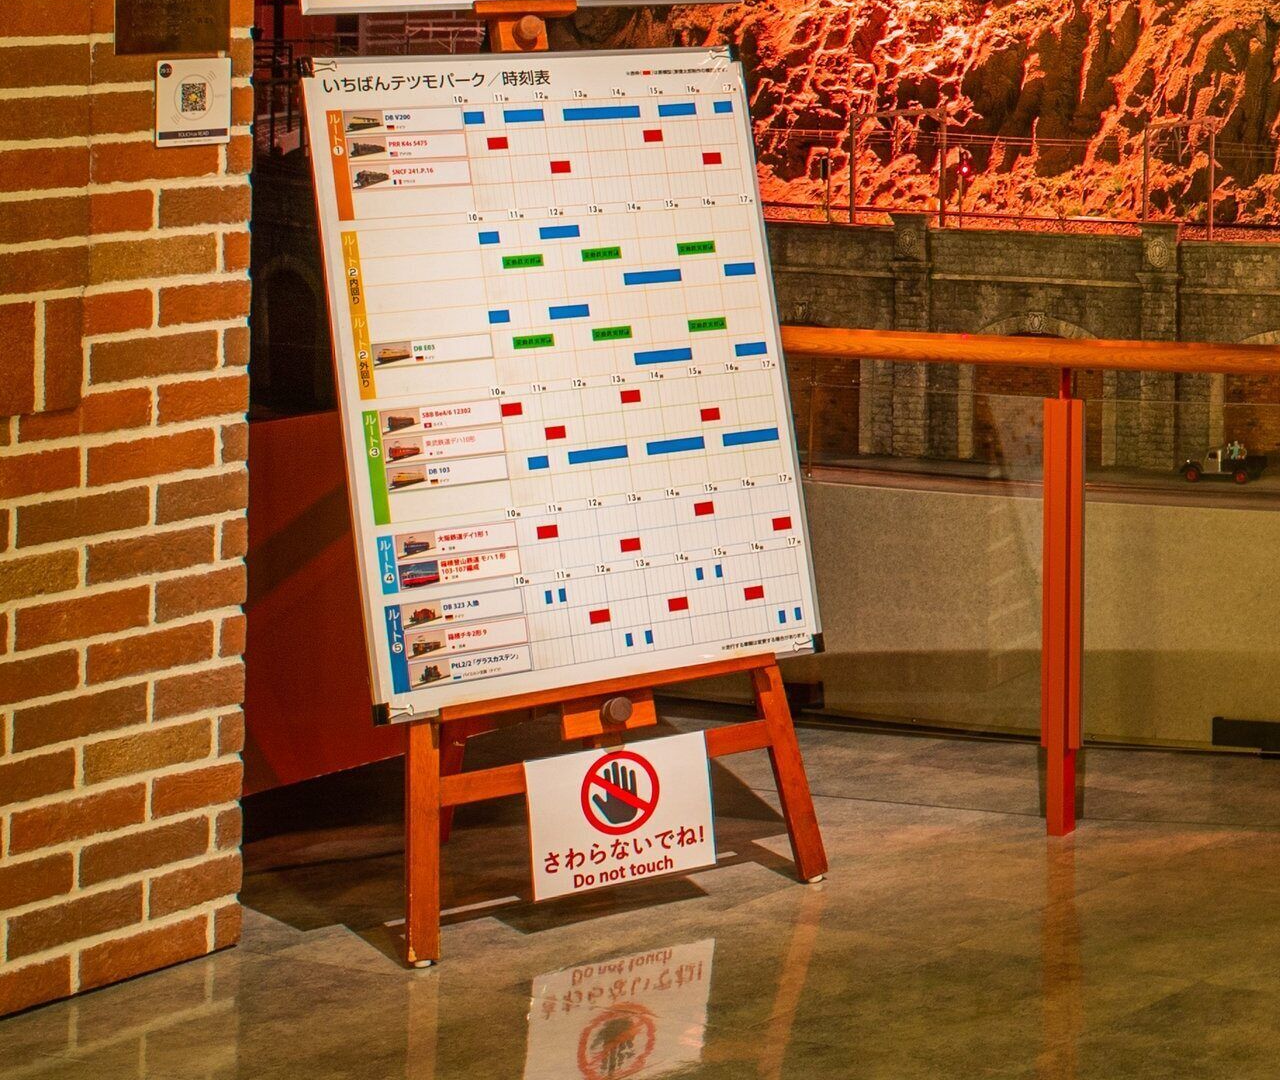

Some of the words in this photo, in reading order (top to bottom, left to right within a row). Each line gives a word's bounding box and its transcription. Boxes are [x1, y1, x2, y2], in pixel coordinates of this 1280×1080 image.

[323, 70, 551, 93] いちばんテツモパーク／時刻表
[573, 874, 595, 889] Do
[599, 865, 626, 883] not
[629, 855, 674, 877] touch
